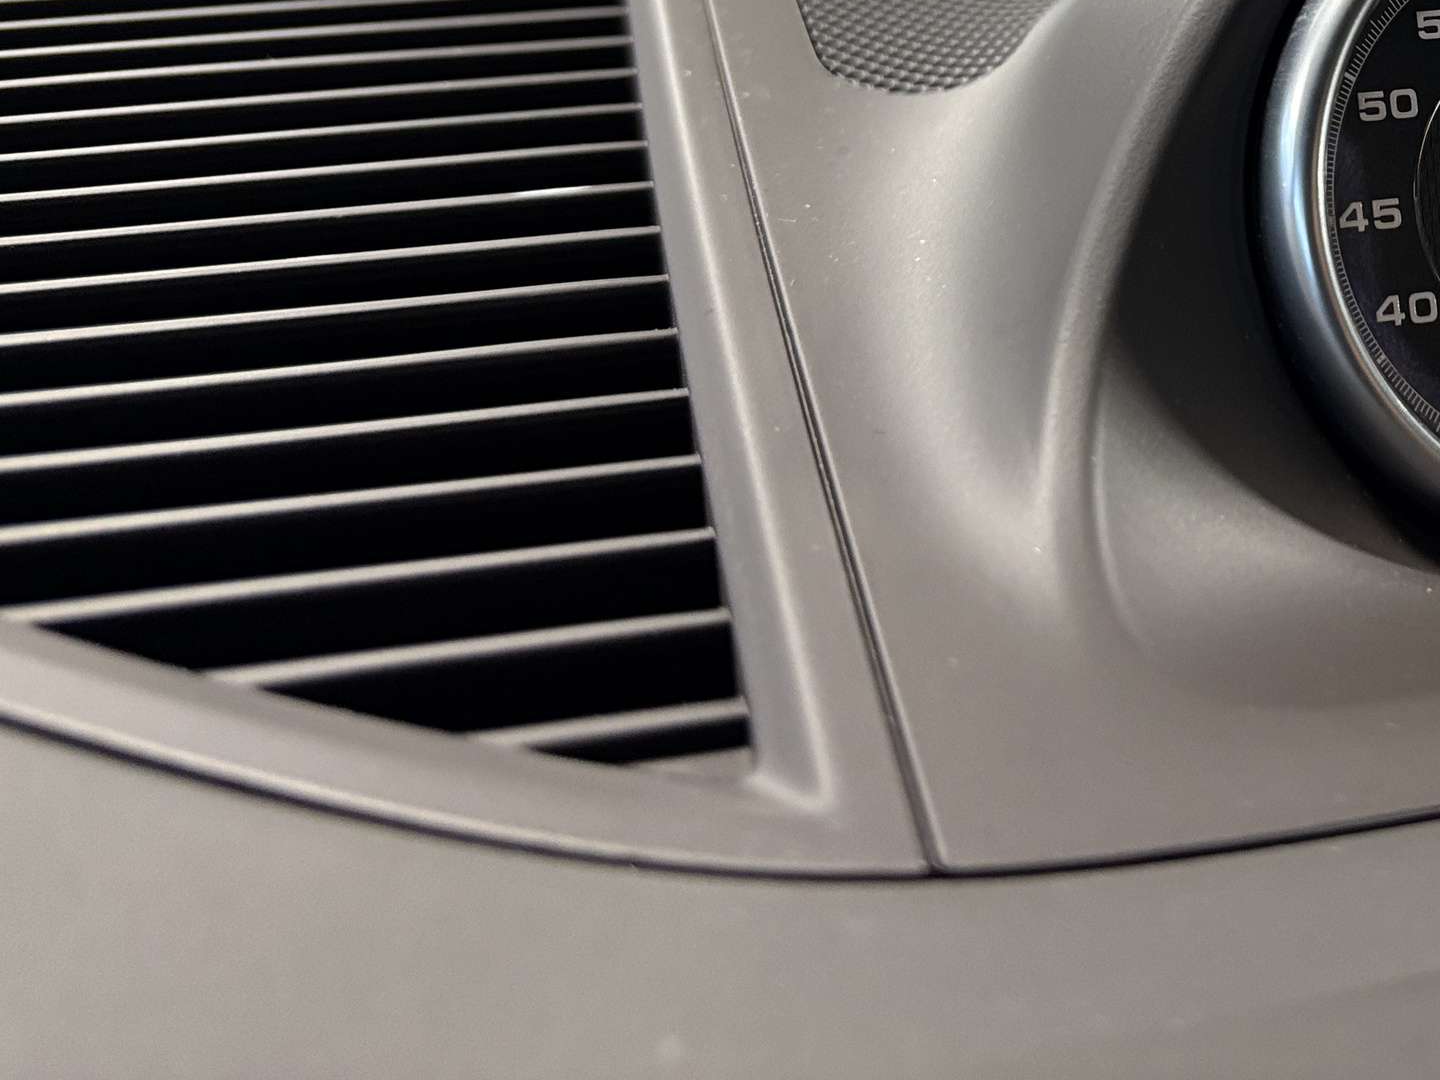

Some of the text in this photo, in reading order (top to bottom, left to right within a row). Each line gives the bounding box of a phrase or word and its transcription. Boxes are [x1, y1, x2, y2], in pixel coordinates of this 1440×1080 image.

[1357, 88, 1419, 121] 50
[1339, 198, 1402, 232] 45
[1376, 291, 1438, 326] 40
